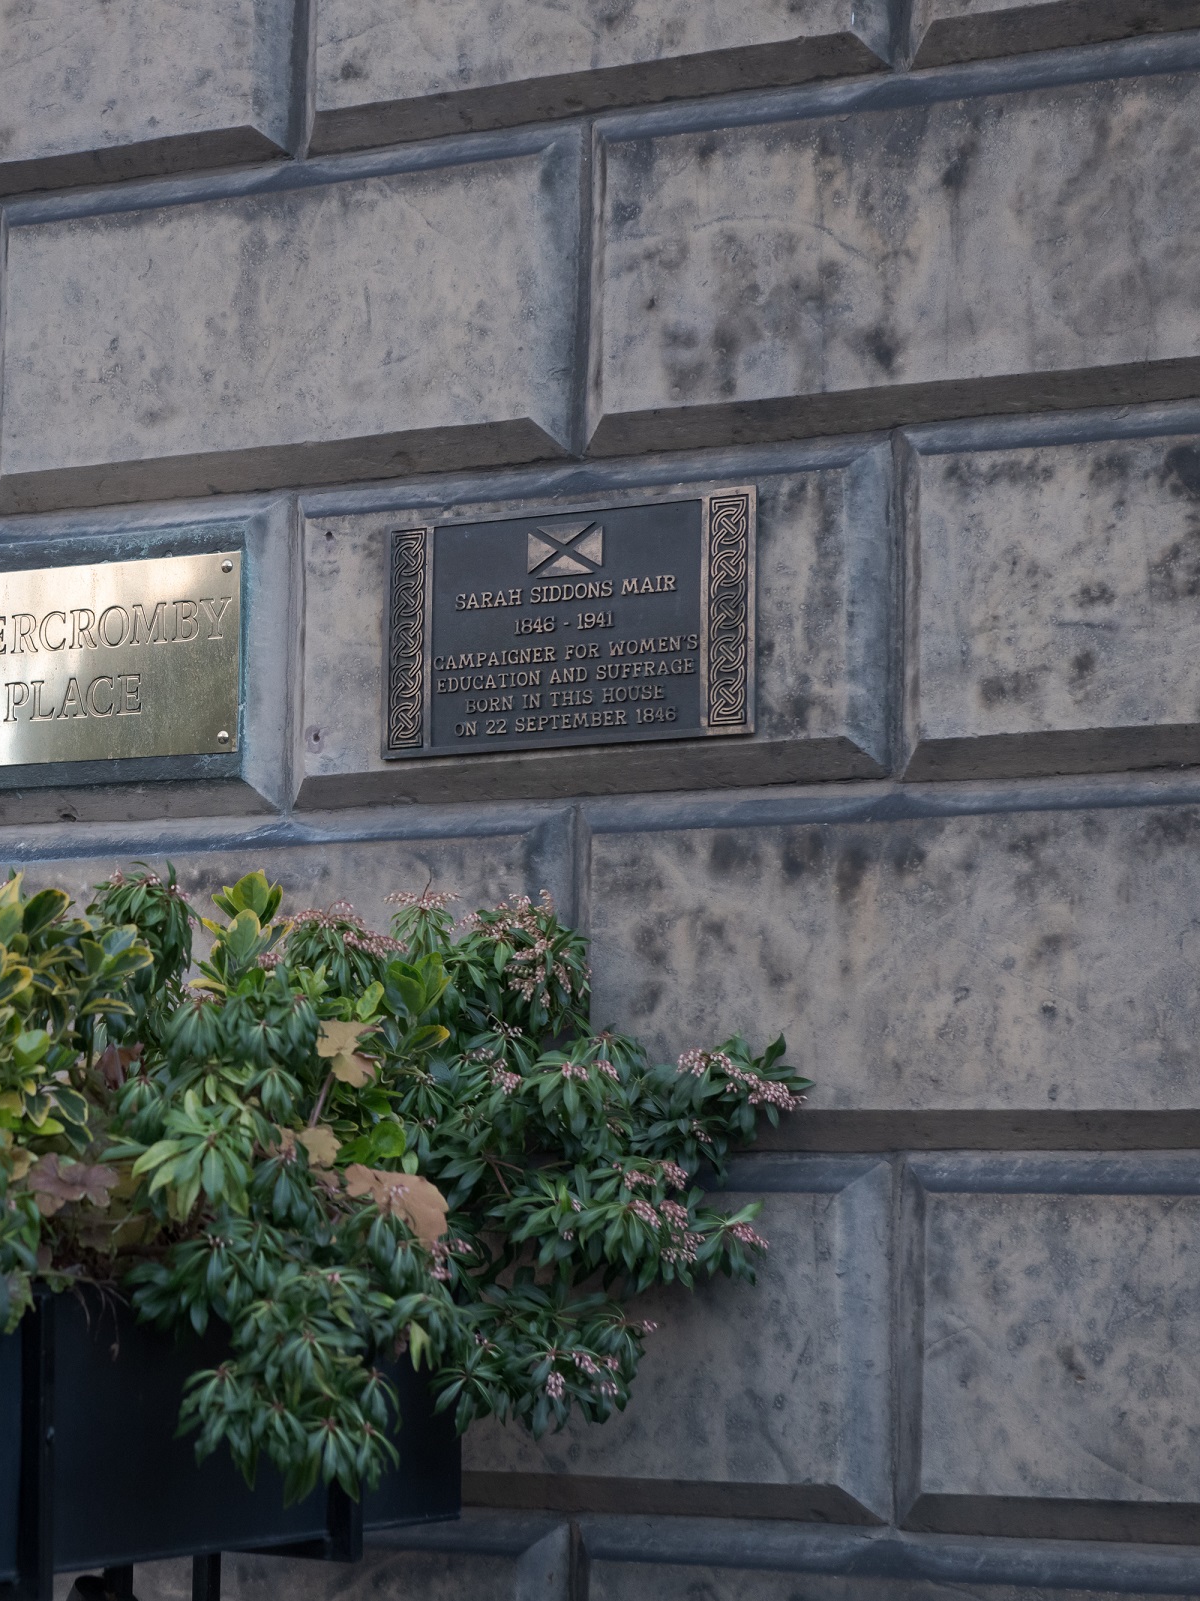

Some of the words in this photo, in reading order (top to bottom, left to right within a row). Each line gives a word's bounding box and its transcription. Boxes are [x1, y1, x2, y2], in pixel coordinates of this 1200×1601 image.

[455, 590, 522, 611] SARAH
[530, 581, 612, 604] SIDDONS
[621, 575, 676, 595] MAIR
[514, 618, 555, 636] 1846
[577, 610, 614, 630] 1941
[434, 647, 555, 672] CAMPAIGNER
[565, 643, 600, 660] FOR
[609, 634, 698, 657] WOMEN'S
[437, 670, 540, 693] EDUCATION
[550, 667, 588, 685] AND
[596, 659, 695, 680] SUFFRAGE
[3, 673, 141, 722] PLACE
[466, 696, 513, 715] BORN
[523, 693, 540, 710] IN
[550, 687, 593, 707] THIS
[602, 686, 665, 703] HOUSE
[455, 720, 477, 737] ON
[486, 719, 506, 735] 22
[515, 711, 627, 733] SEPTEMBER
[636, 706, 677, 723] 1846
